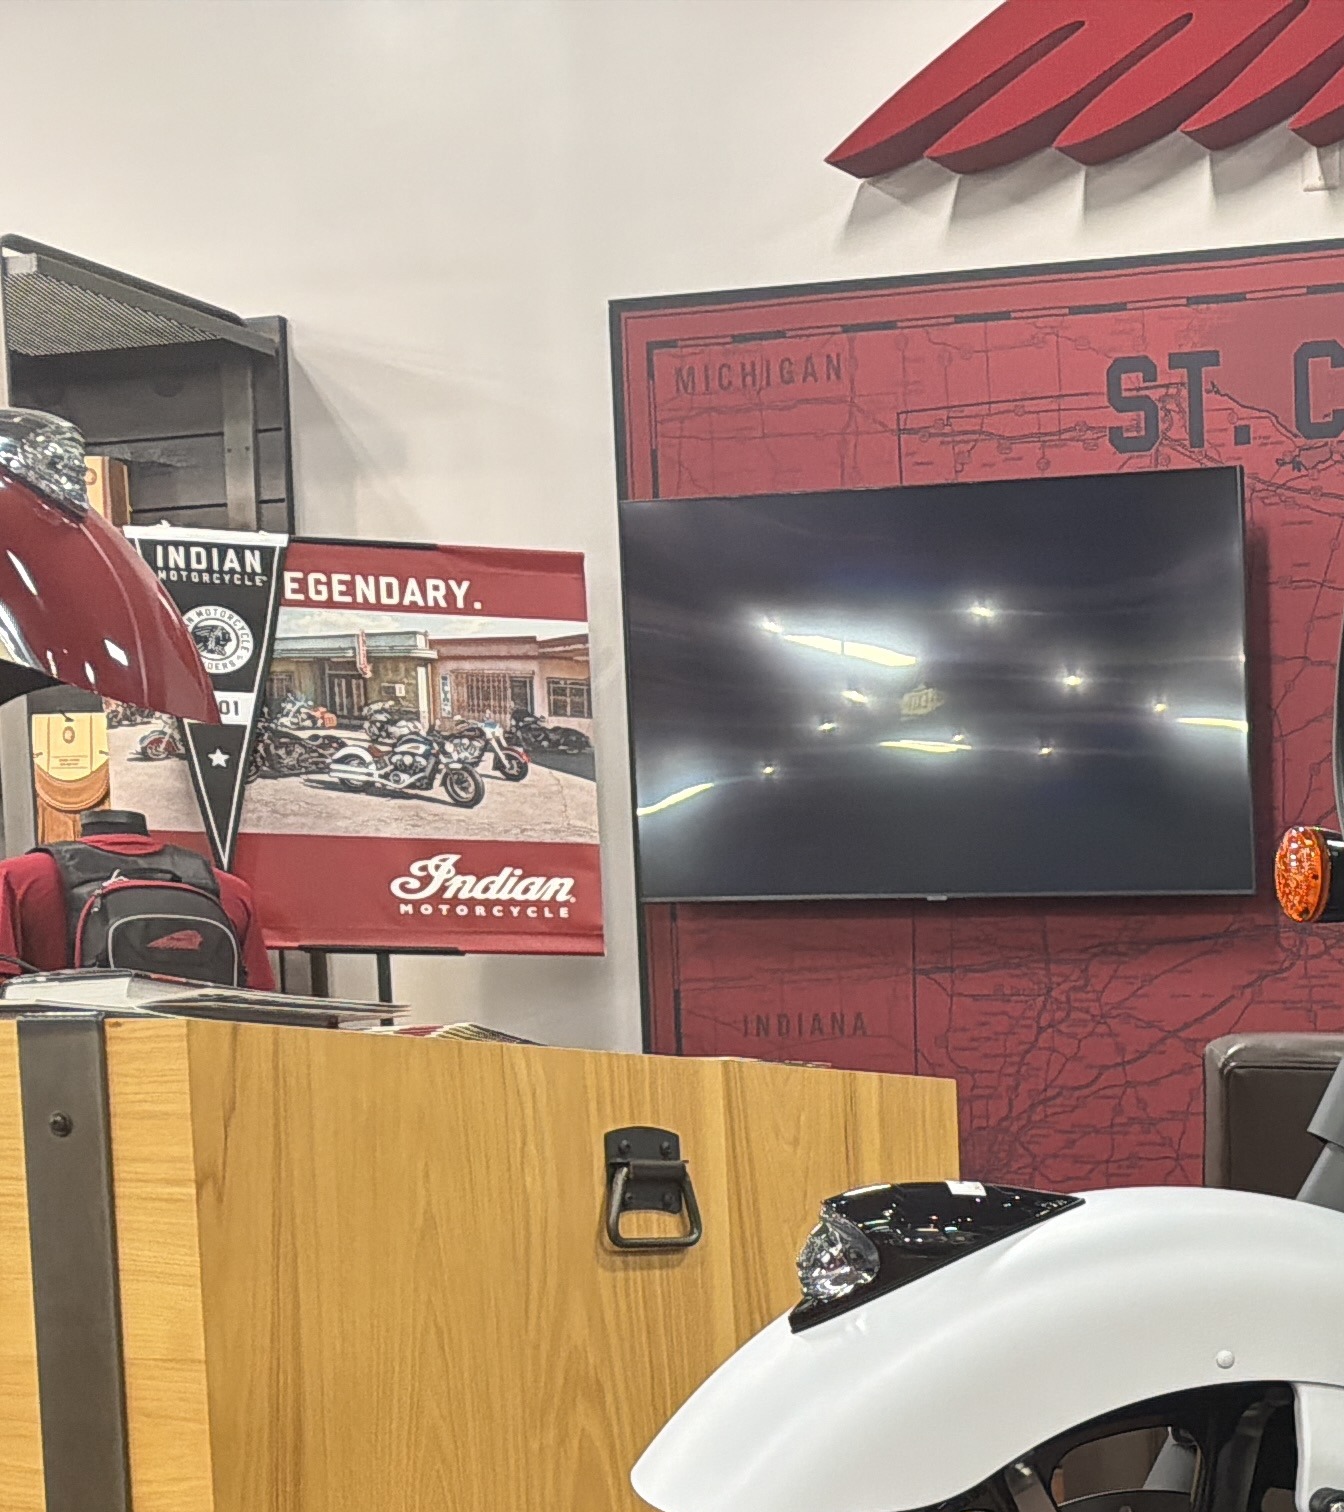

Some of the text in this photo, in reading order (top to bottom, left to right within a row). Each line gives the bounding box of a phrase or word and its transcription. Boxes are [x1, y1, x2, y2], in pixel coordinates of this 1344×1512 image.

[674, 353, 844, 396] MICHIGAN
[1106, 350, 1252, 454] ST.
[156, 544, 263, 574] INDIAN
[157, 570, 265, 587] MOTORCYCLE
[284, 571, 482, 610] EGENDARY.
[195, 607, 250, 654] MOTORCYCLE
[206, 660, 237, 671] DERS
[218, 699, 240, 717] 01
[390, 853, 576, 903] Indian
[399, 903, 570, 918] MOTORCYCLE
[742, 1011, 868, 1038] INDIANA
